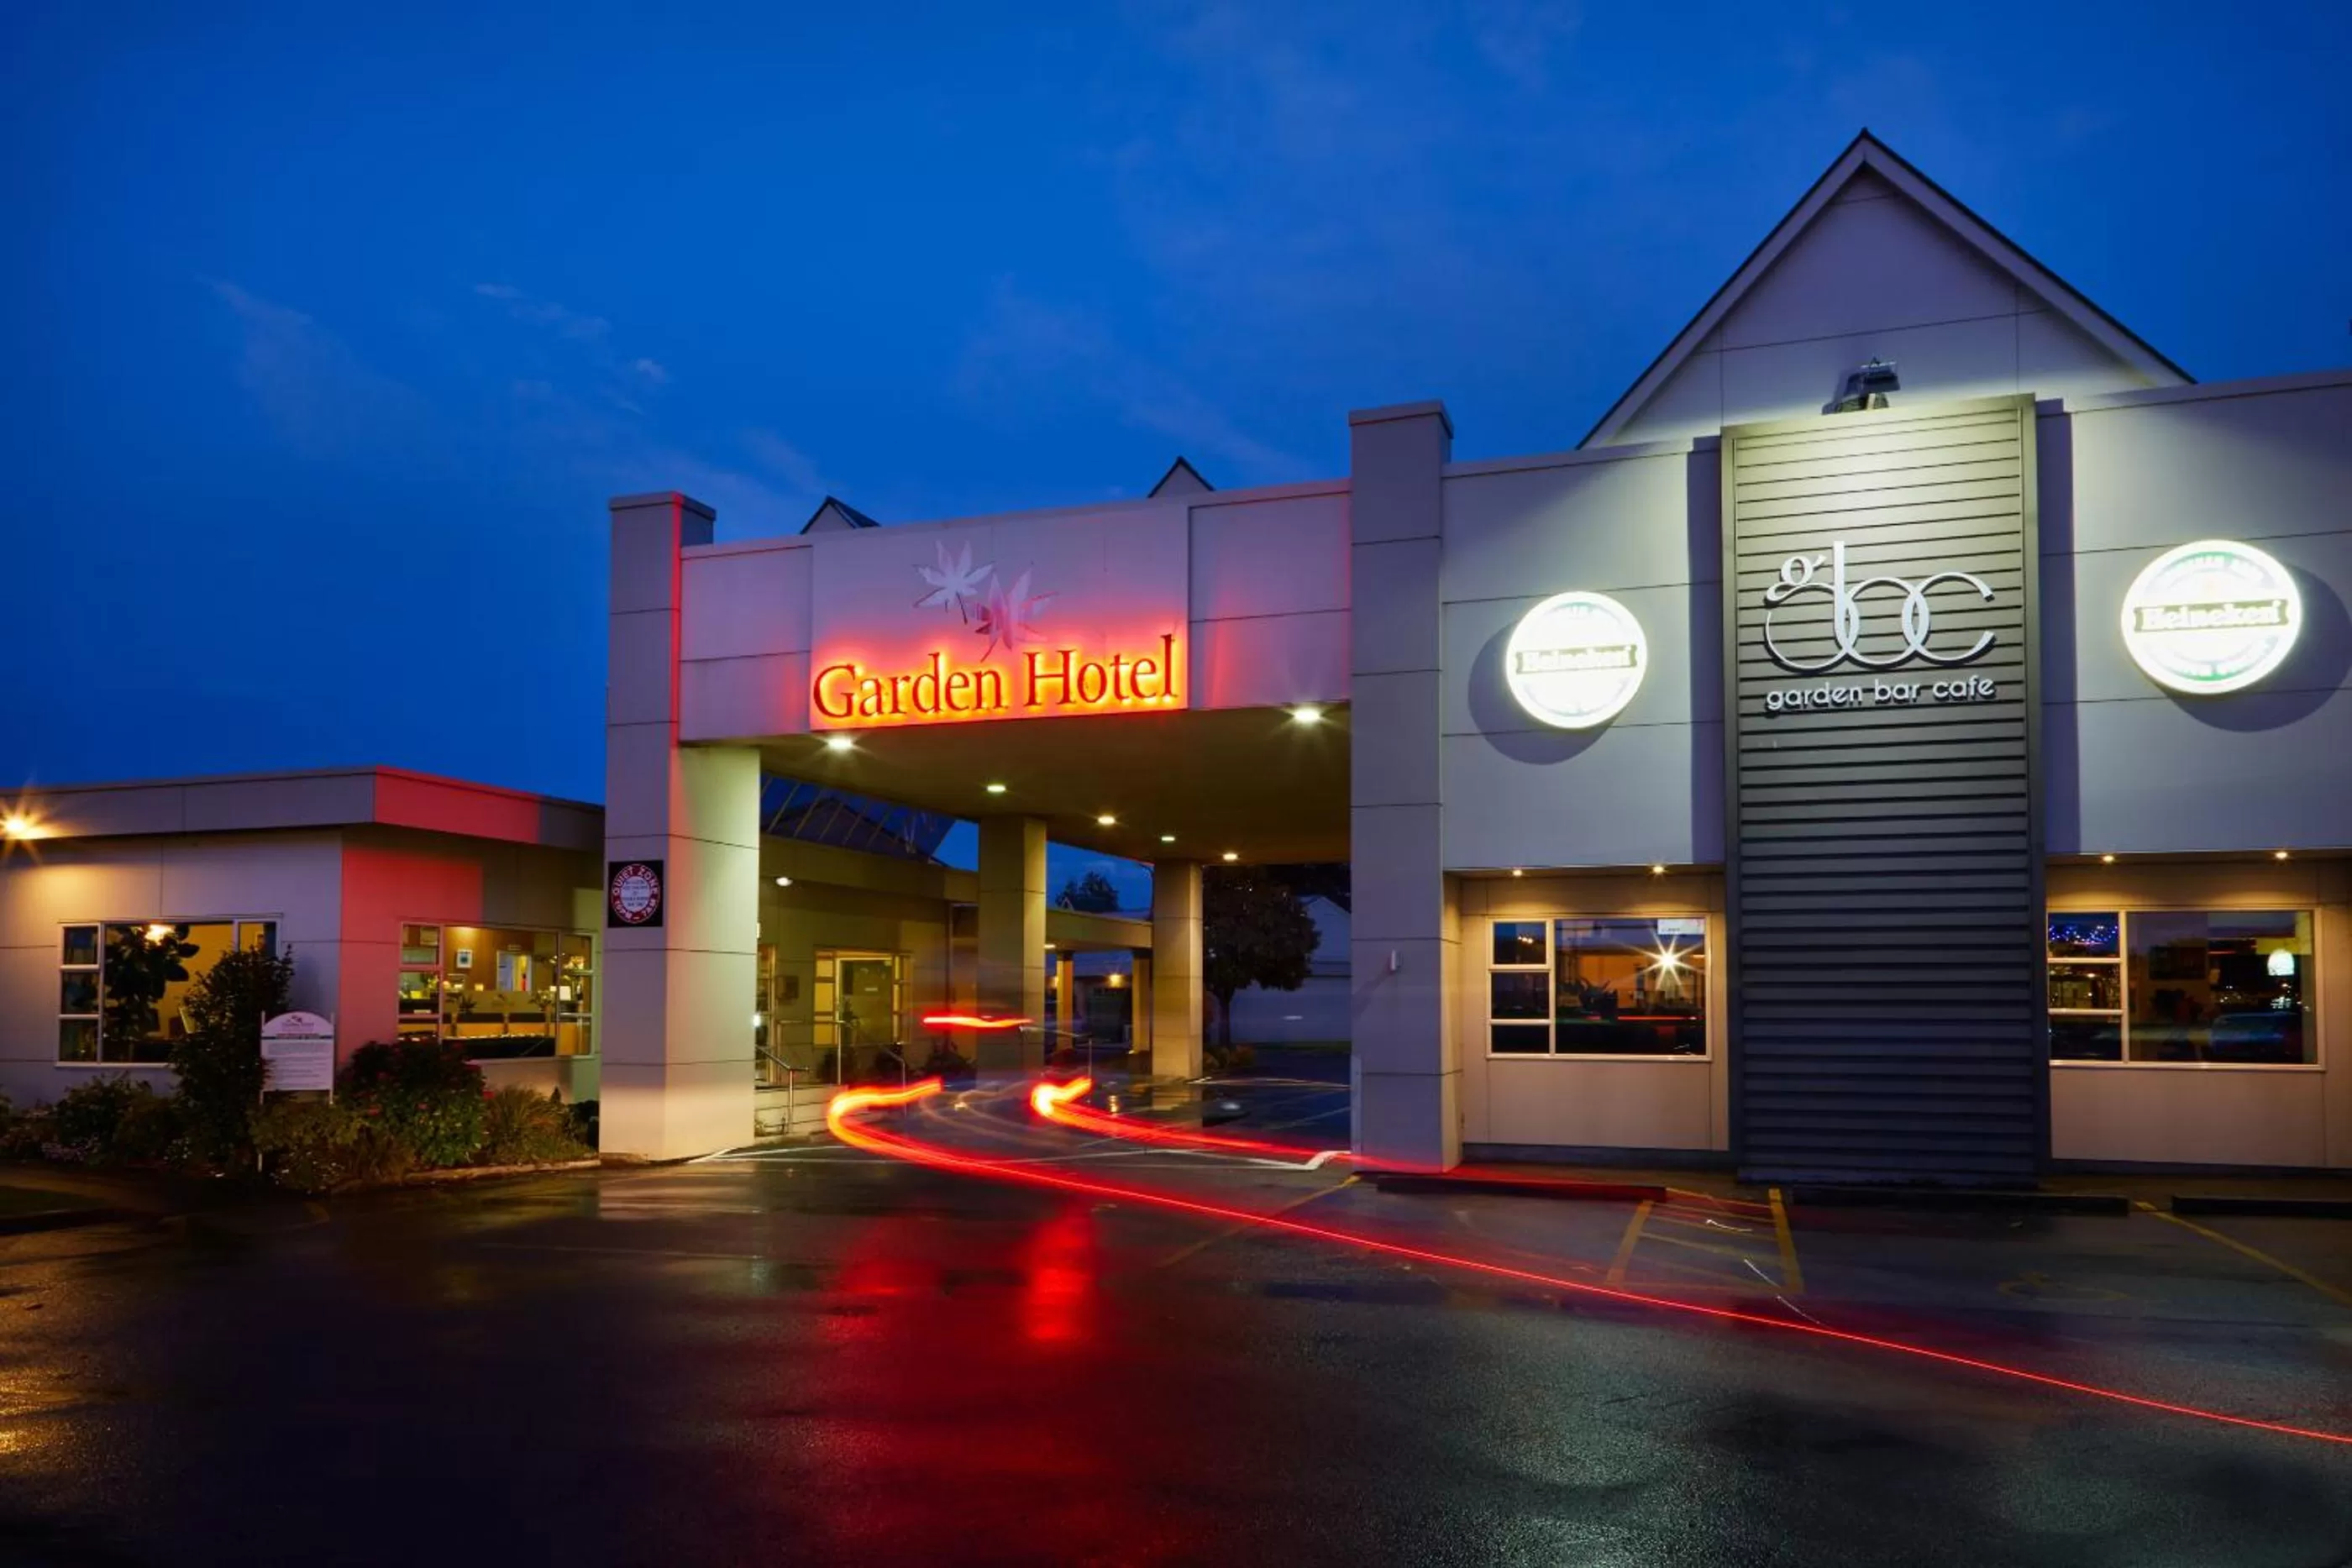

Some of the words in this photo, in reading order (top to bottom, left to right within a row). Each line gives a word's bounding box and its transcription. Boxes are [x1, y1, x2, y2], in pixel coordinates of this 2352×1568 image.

[813, 653, 1008, 719] Garden
[1023, 633, 1179, 707] Hotel
[1767, 682, 1863, 711] garden
[1875, 678, 1921, 700] bar
[1932, 674, 1994, 698] cafe
